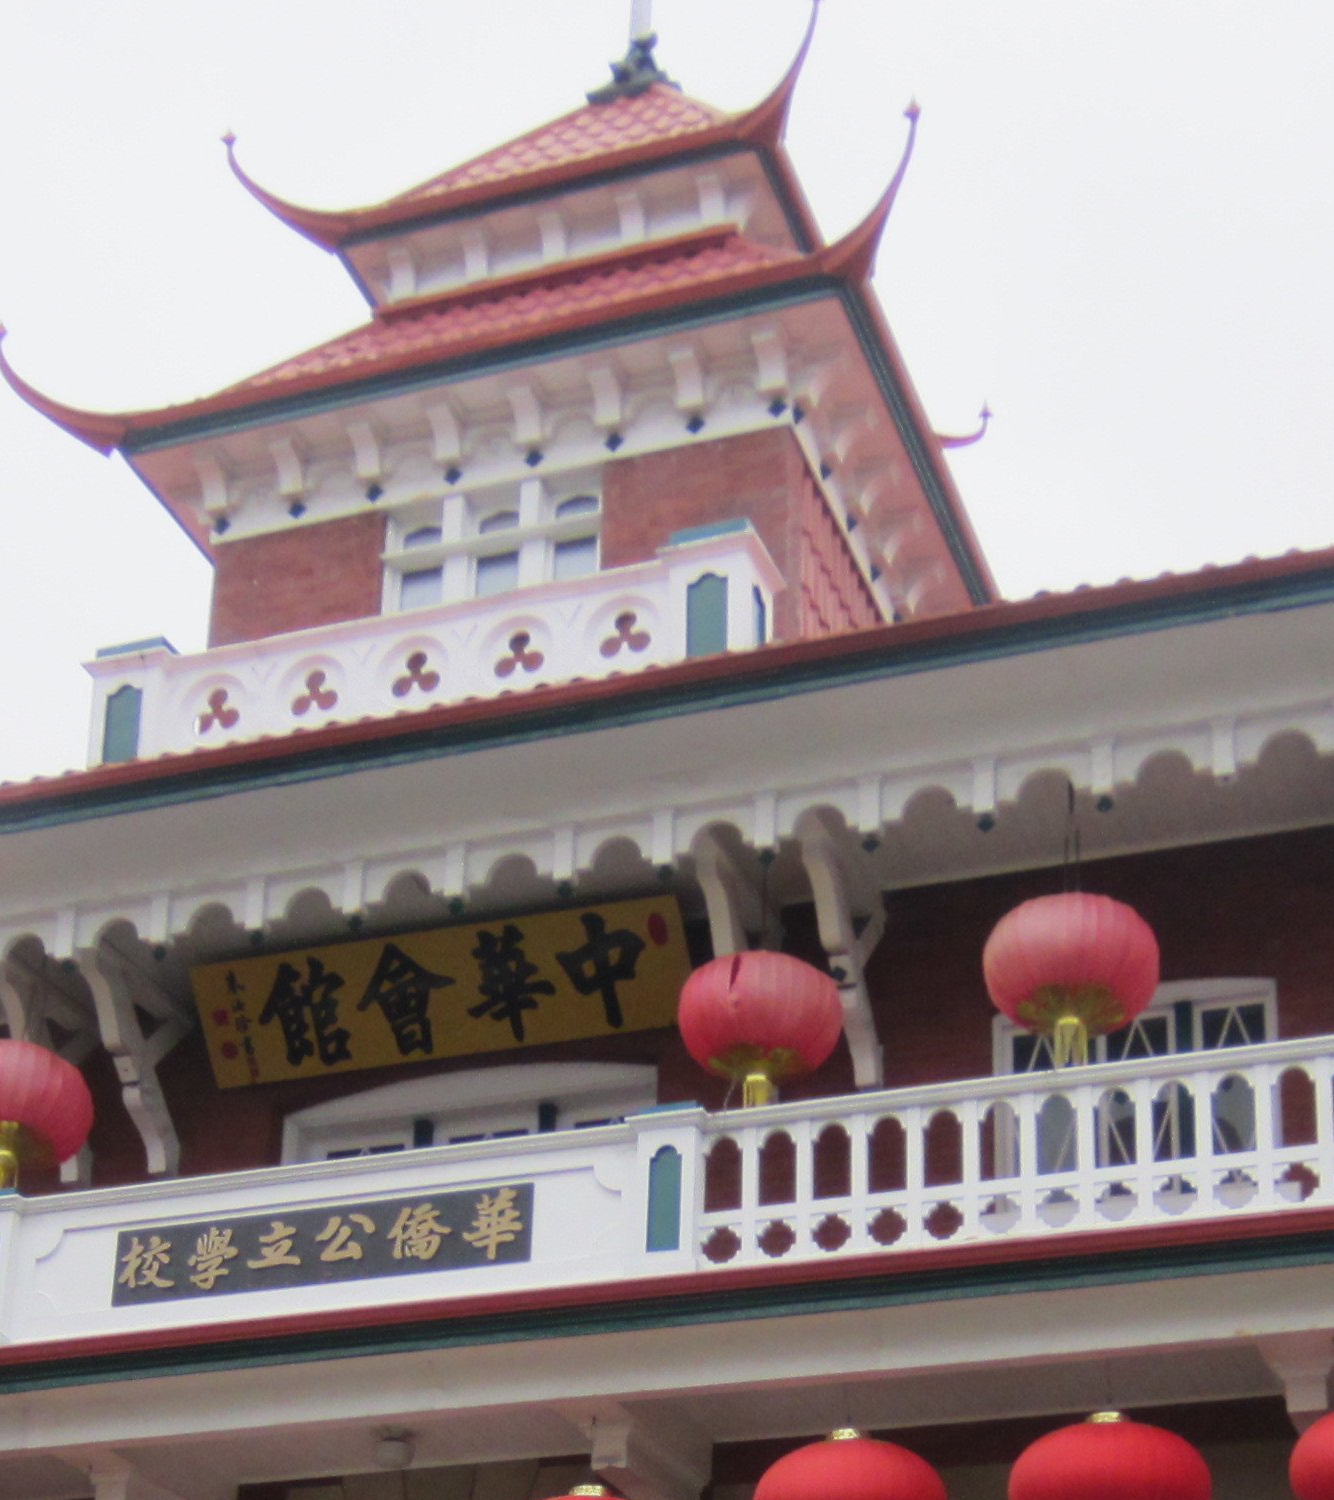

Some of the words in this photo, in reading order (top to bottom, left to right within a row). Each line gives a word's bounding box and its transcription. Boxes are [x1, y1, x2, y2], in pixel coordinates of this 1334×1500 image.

[259, 911, 646, 1066] 中華會館
[117, 1188, 525, 1290] 華僑公立學校
